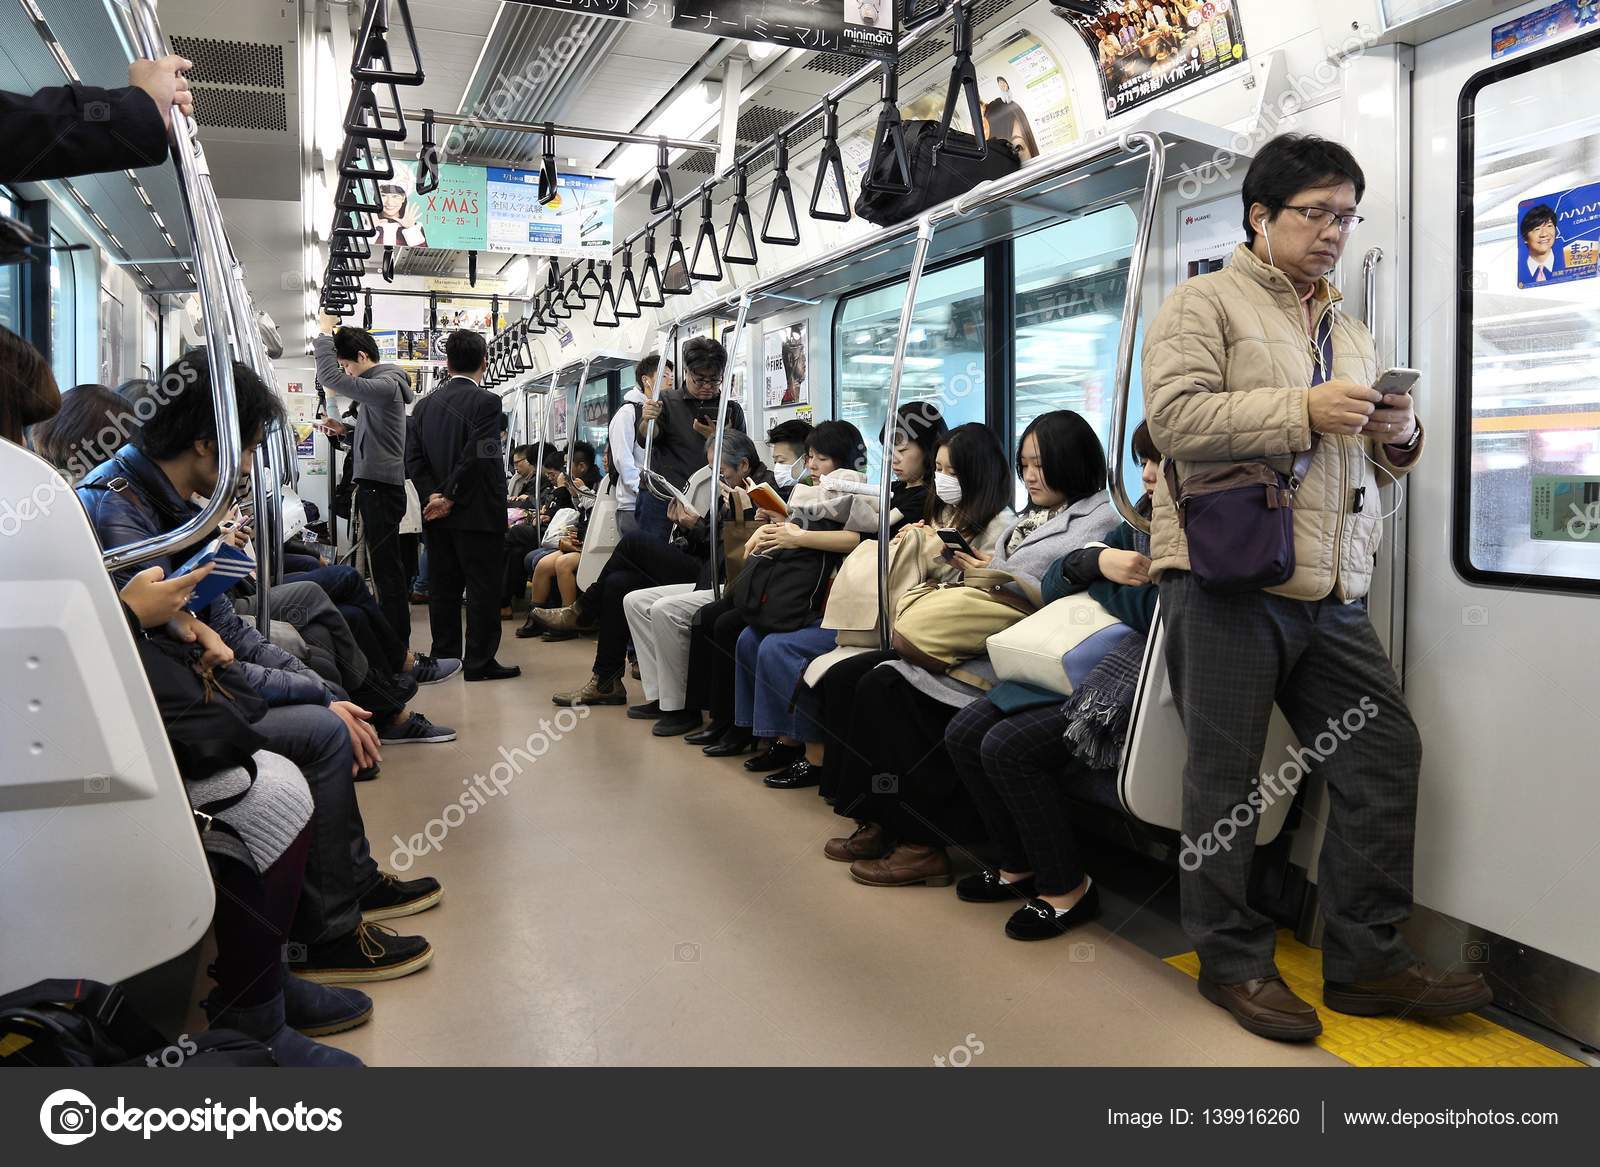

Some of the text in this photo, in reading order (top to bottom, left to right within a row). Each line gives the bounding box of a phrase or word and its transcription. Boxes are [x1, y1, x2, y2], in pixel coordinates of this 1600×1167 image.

[556, 0, 839, 51] ットクリーナー「ミニマル」
[843, 27, 893, 45] minimaru
[770, 358, 783, 372] FIRE
